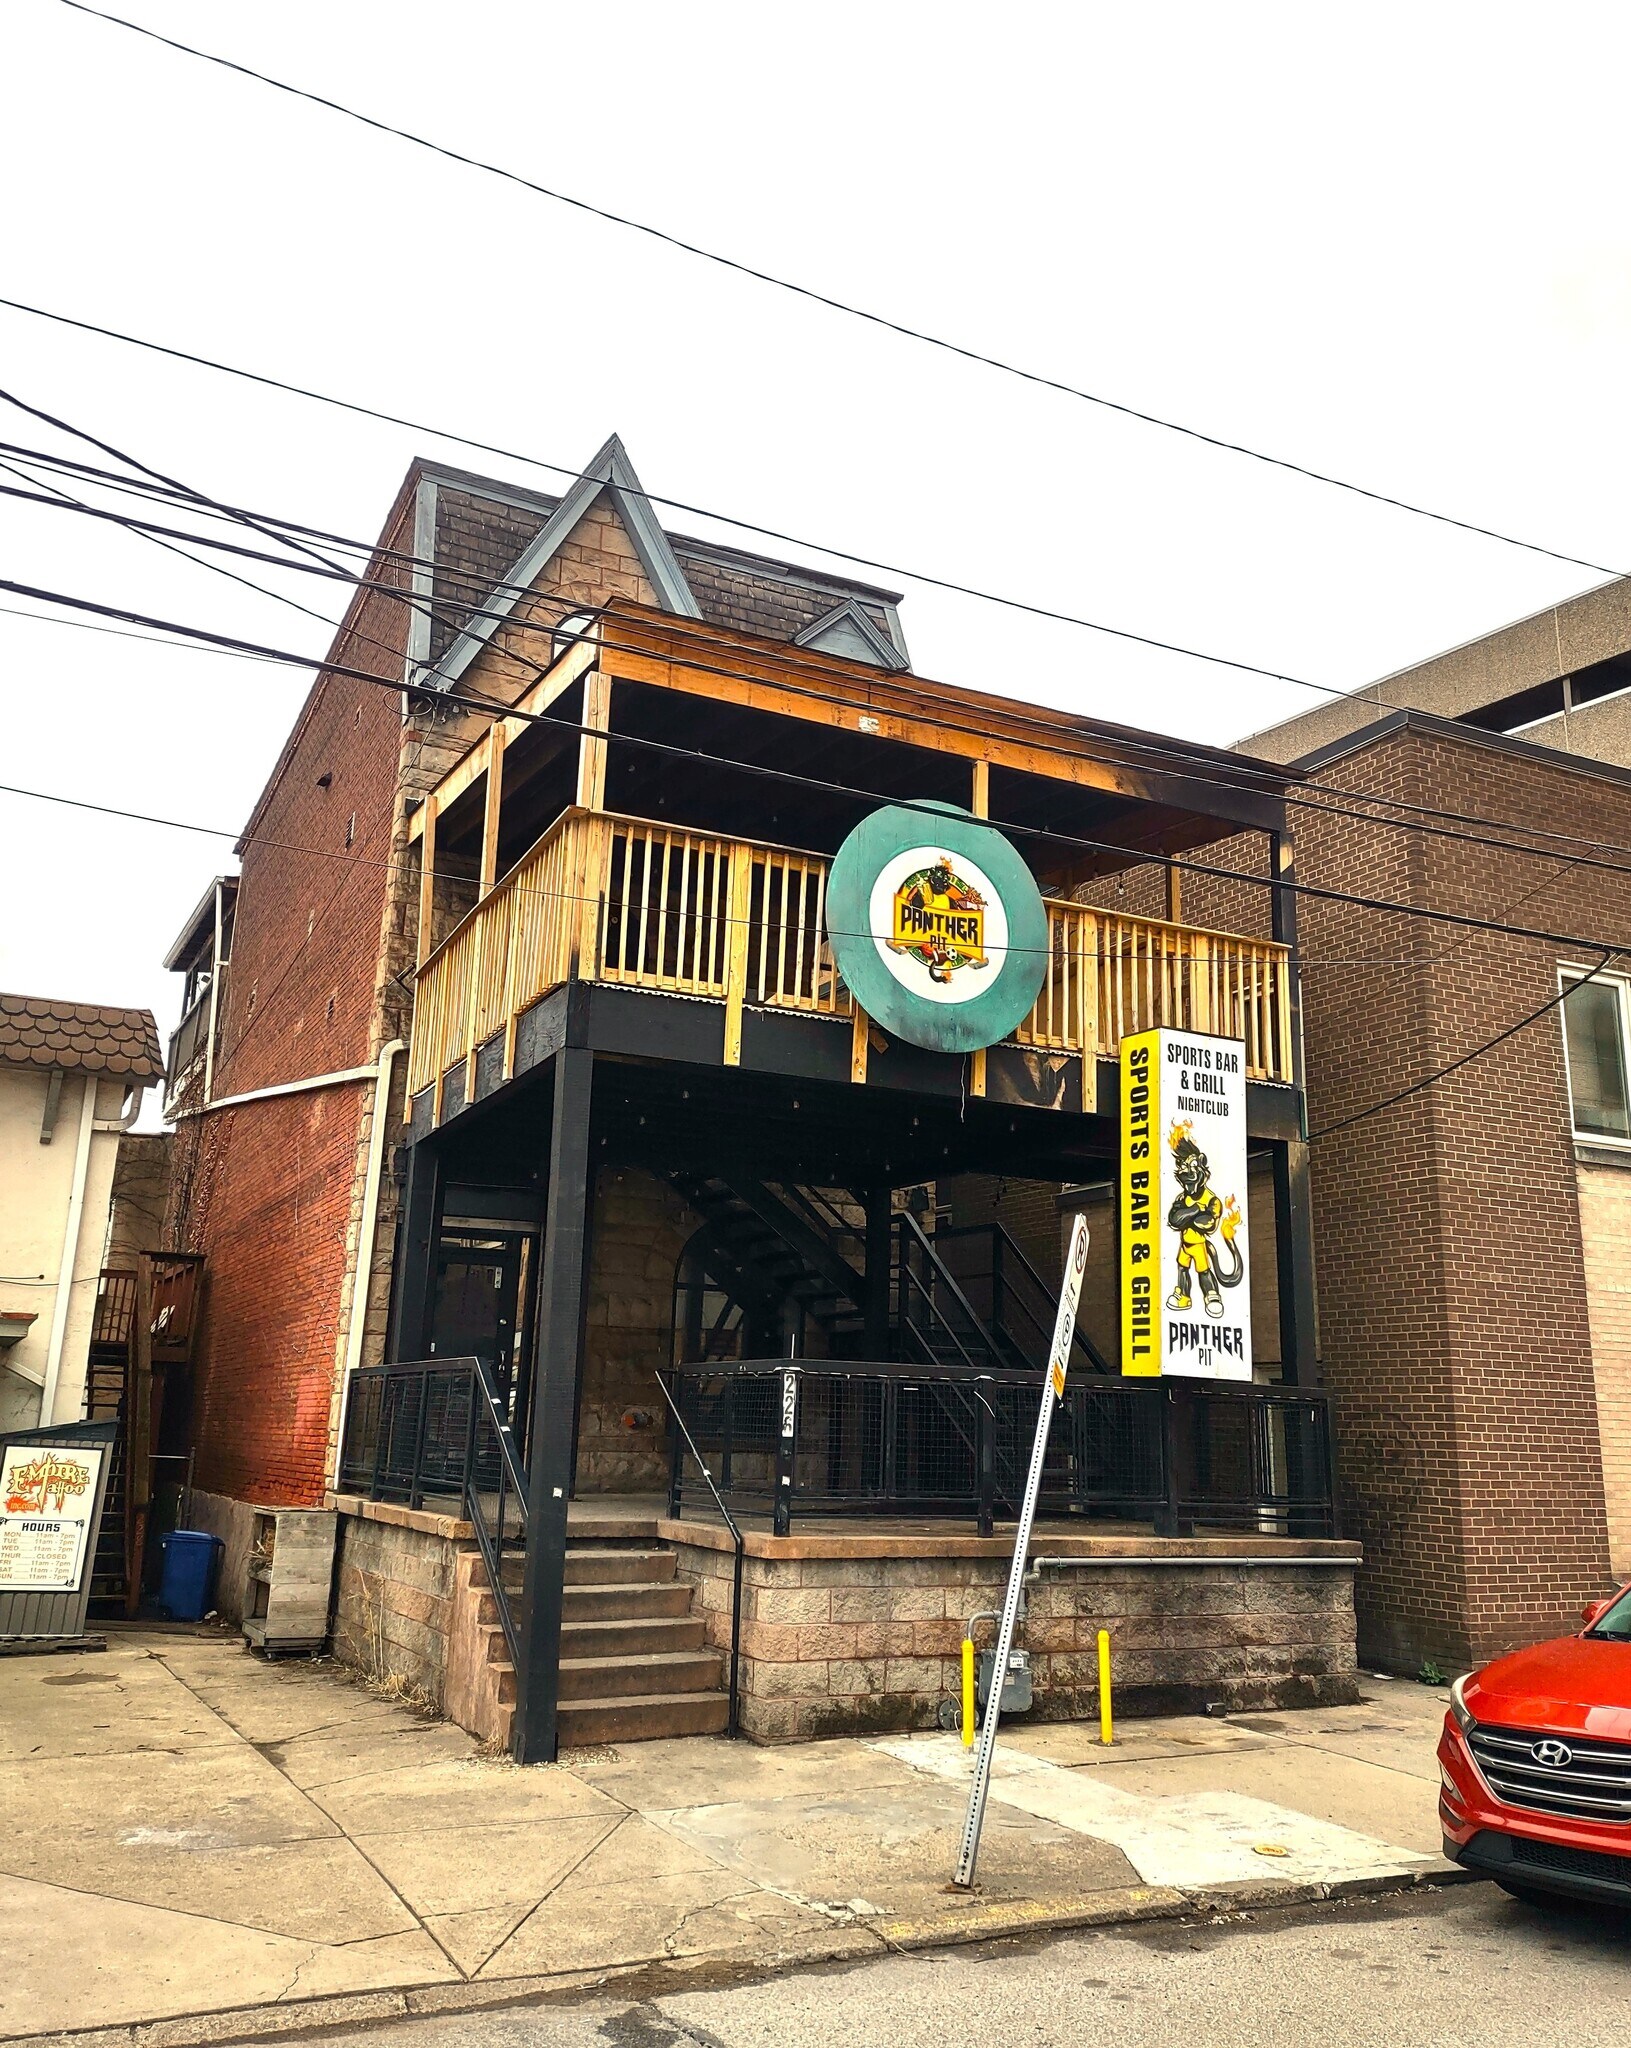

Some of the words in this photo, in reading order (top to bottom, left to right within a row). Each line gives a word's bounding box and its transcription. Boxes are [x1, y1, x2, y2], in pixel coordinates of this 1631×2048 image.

[901, 903, 978, 946] PANTHER
[930, 933, 947, 951] PIT
[1167, 1043, 1211, 1069] SPORTS
[1216, 1051, 1238, 1073] BAR
[1180, 1070, 1189, 1090] &
[1194, 1072, 1226, 1096] GRILL
[1130, 1047, 1150, 1160] SPORTS
[1177, 1096, 1229, 1117] NIGHTCLUB
[1131, 1171, 1150, 1231] BAR
[1131, 1243, 1150, 1265] &
[1132, 1276, 1151, 1360] GRILL
[1169, 1321, 1244, 1362] PANTHER
[1198, 1348, 1212, 1366] PIT
[21, 1522, 61, 1533] HOURS
[60, 1532, 76, 1540] 7pm
[54, 1567, 70, 1575] 7pm
